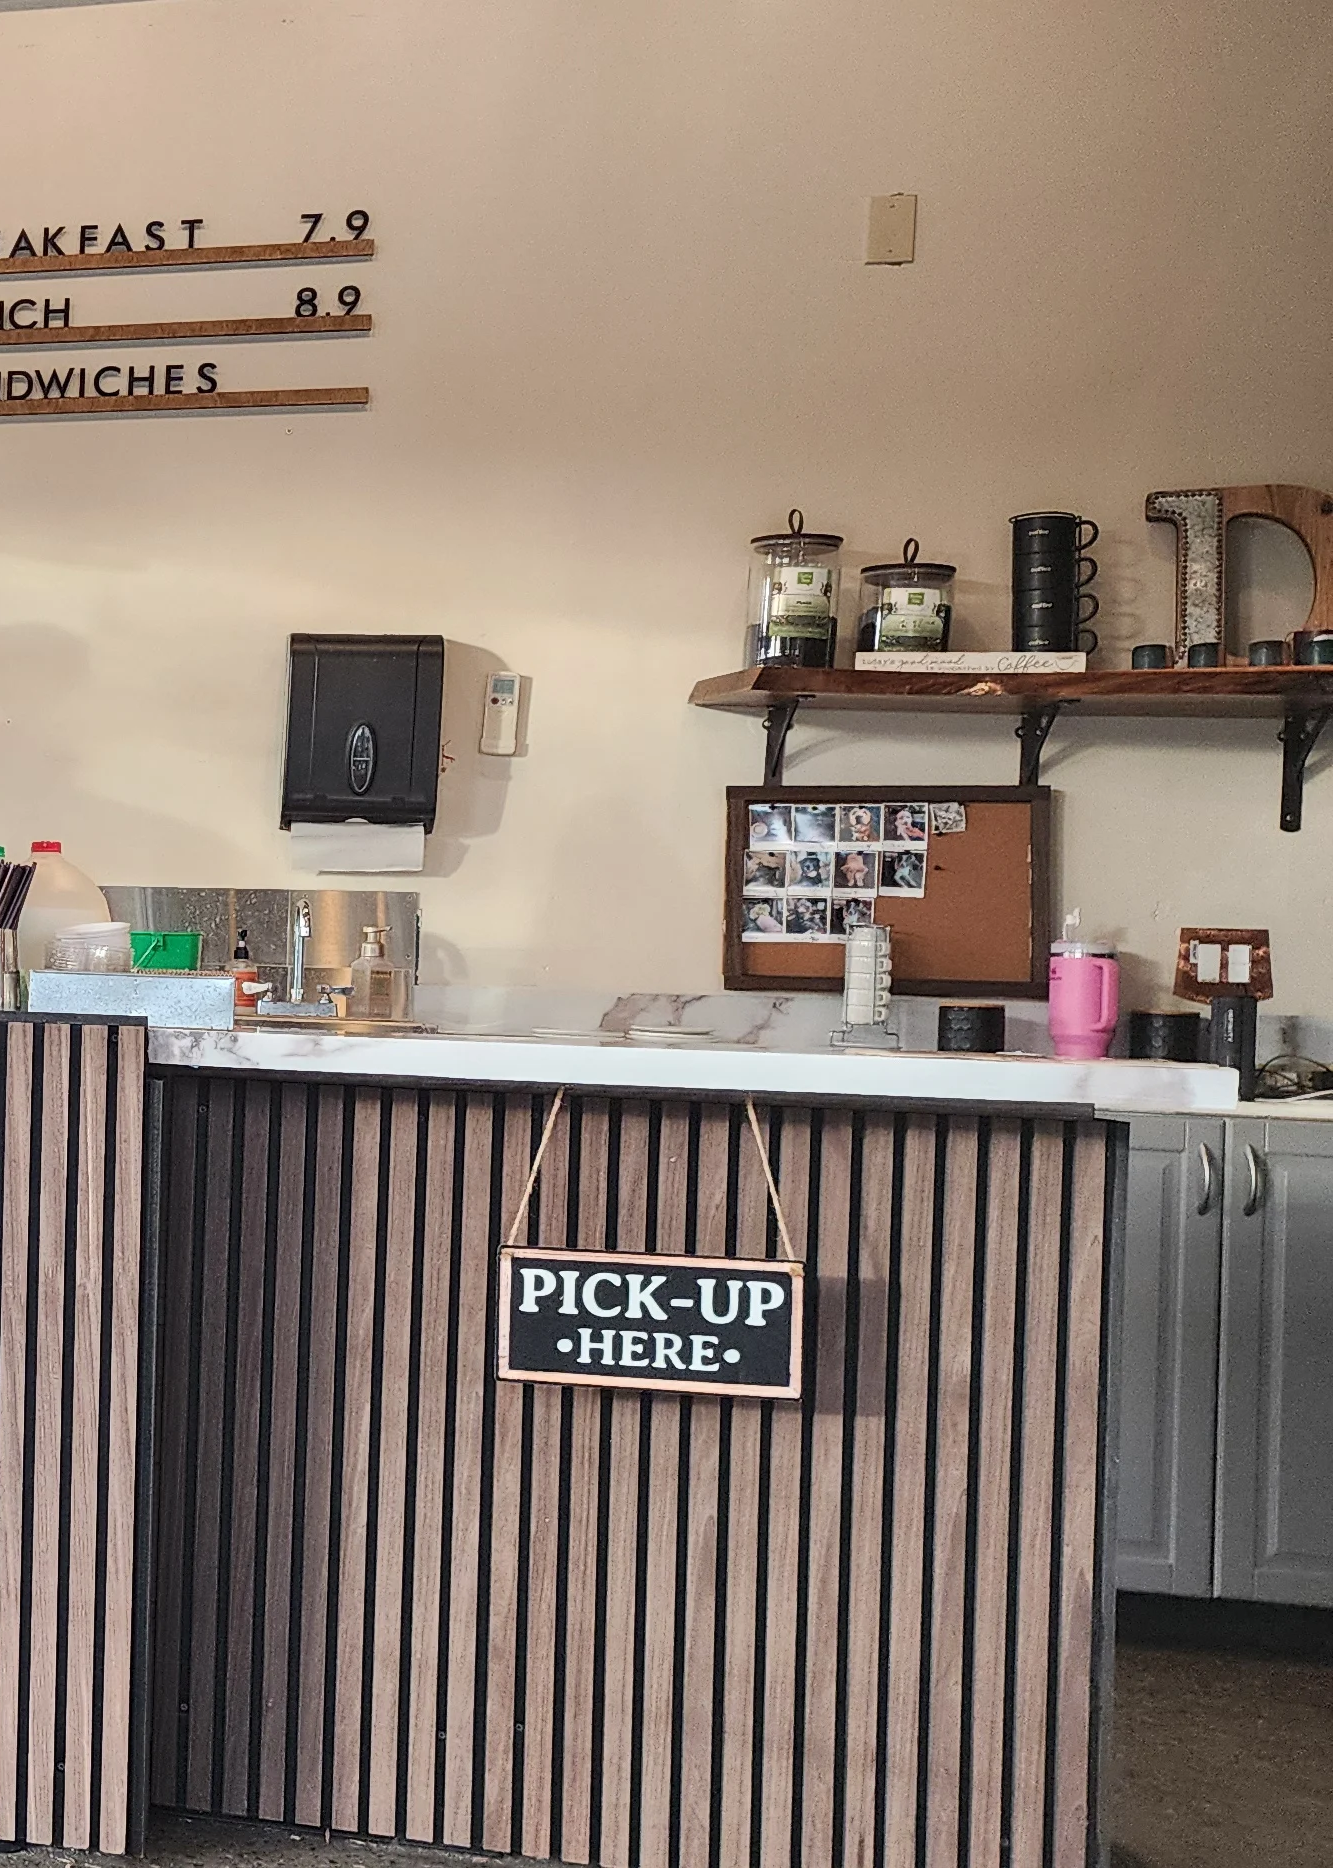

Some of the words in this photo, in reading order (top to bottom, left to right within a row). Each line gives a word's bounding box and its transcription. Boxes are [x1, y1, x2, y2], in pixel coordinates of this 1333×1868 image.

[300, 209, 370, 244] 7.9
[295, 285, 361, 318] 8.9
[997, 655, 1054, 674] Coffee
[518, 1268, 785, 1327] PICK-UP
